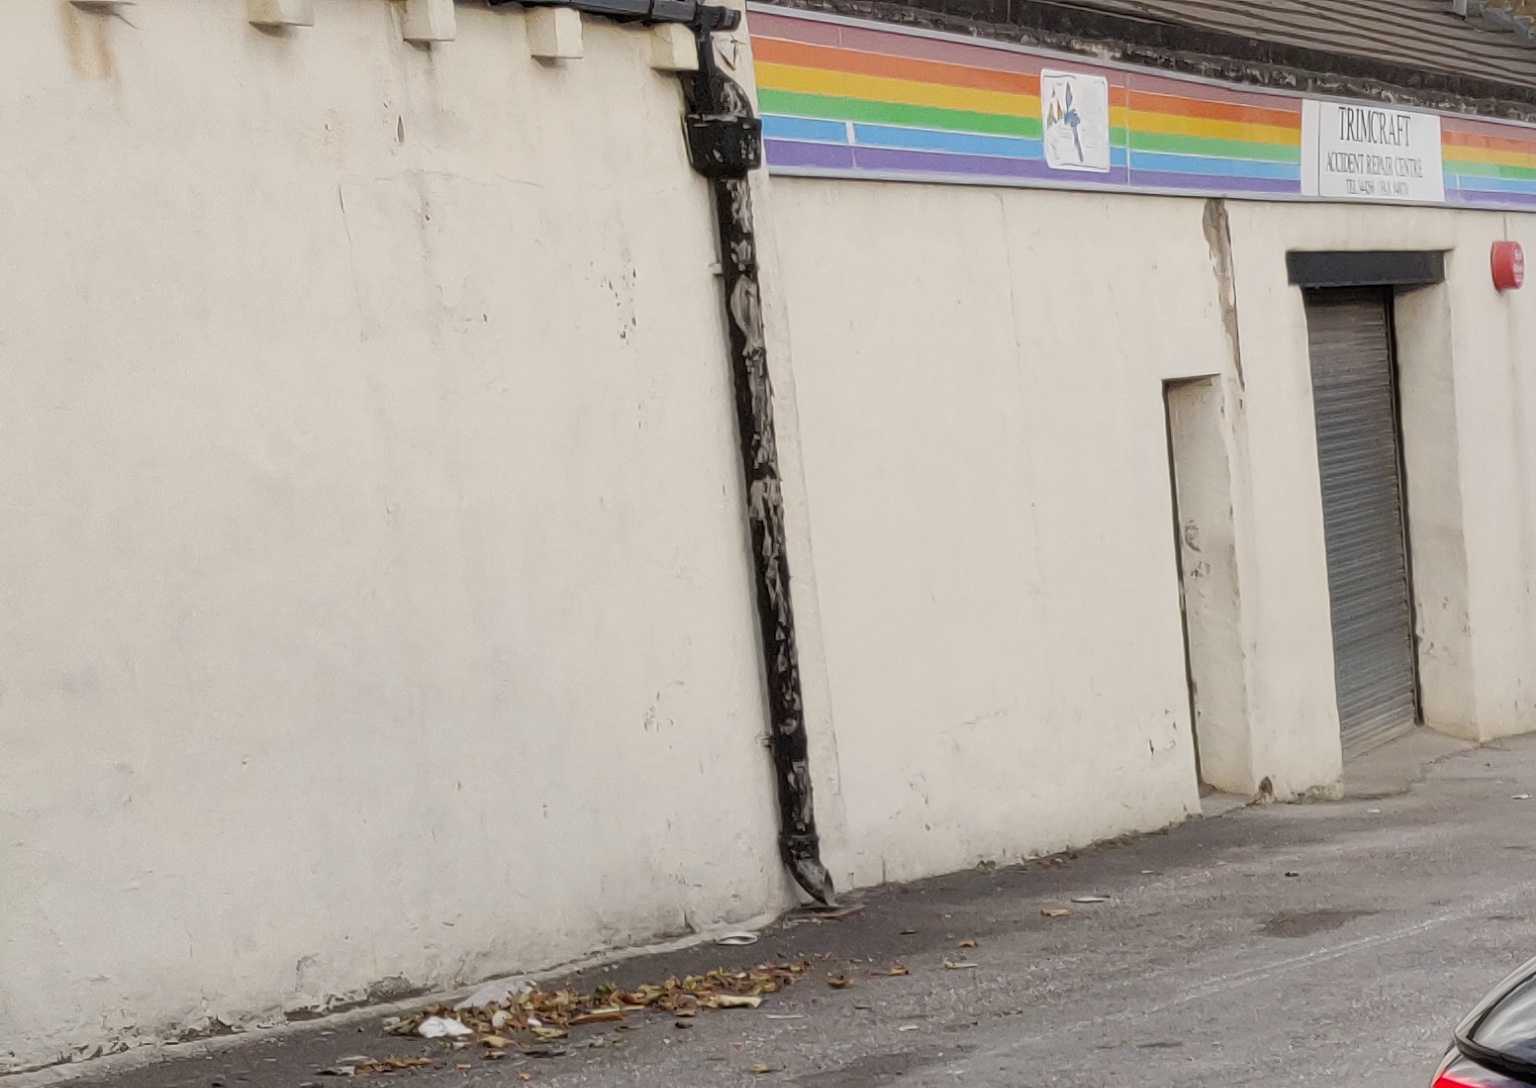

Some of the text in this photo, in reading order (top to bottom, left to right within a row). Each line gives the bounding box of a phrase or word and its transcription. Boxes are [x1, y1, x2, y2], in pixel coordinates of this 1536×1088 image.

[1338, 106, 1411, 147] TRIMCRAFT
[1326, 151, 1423, 178] ACCIDENT REPAIR CENTRE
